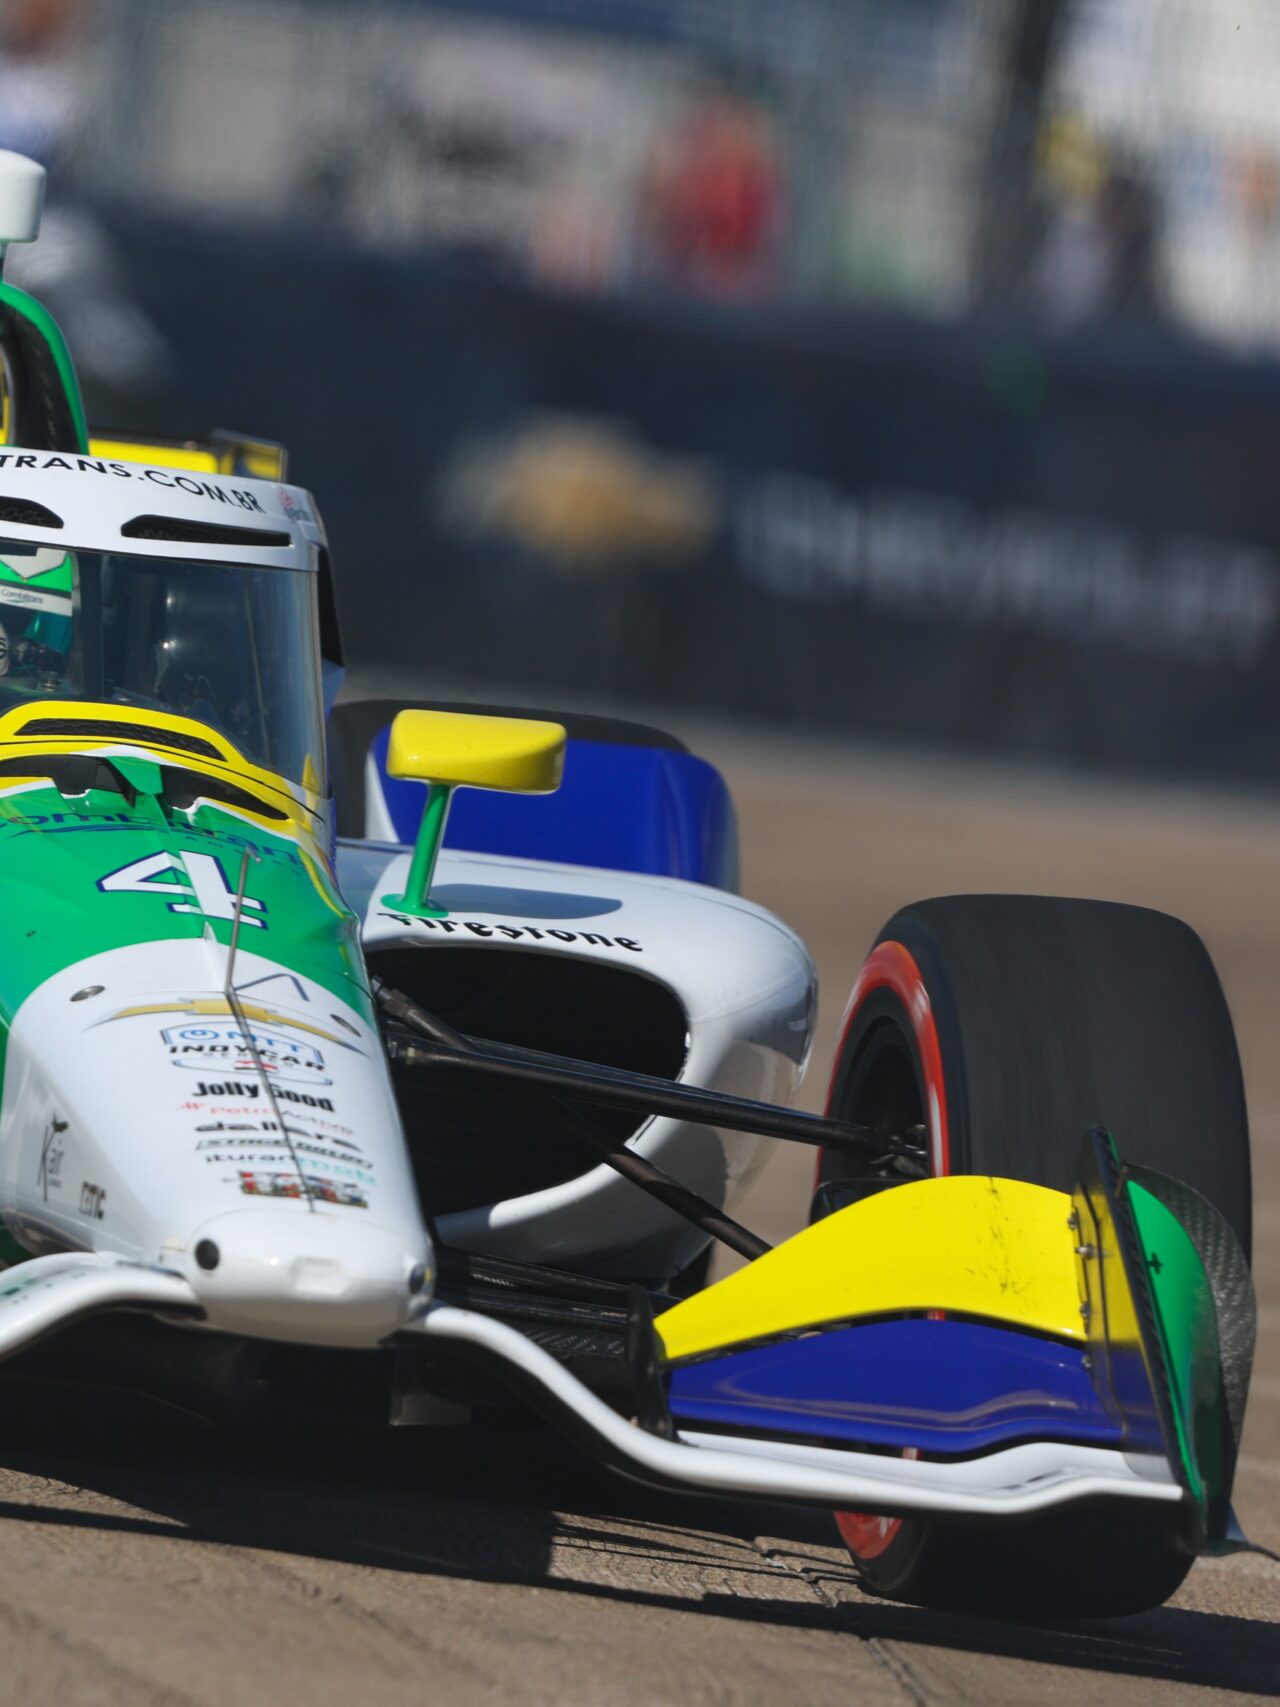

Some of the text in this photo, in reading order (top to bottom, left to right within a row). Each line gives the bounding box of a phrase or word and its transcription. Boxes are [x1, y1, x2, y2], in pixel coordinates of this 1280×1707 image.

[95, 849, 268, 931] 4
[377, 912, 643, 951] Firestone
[170, 1044, 325, 1072] INDYCAR
[193, 1081, 259, 1098] Jolly
